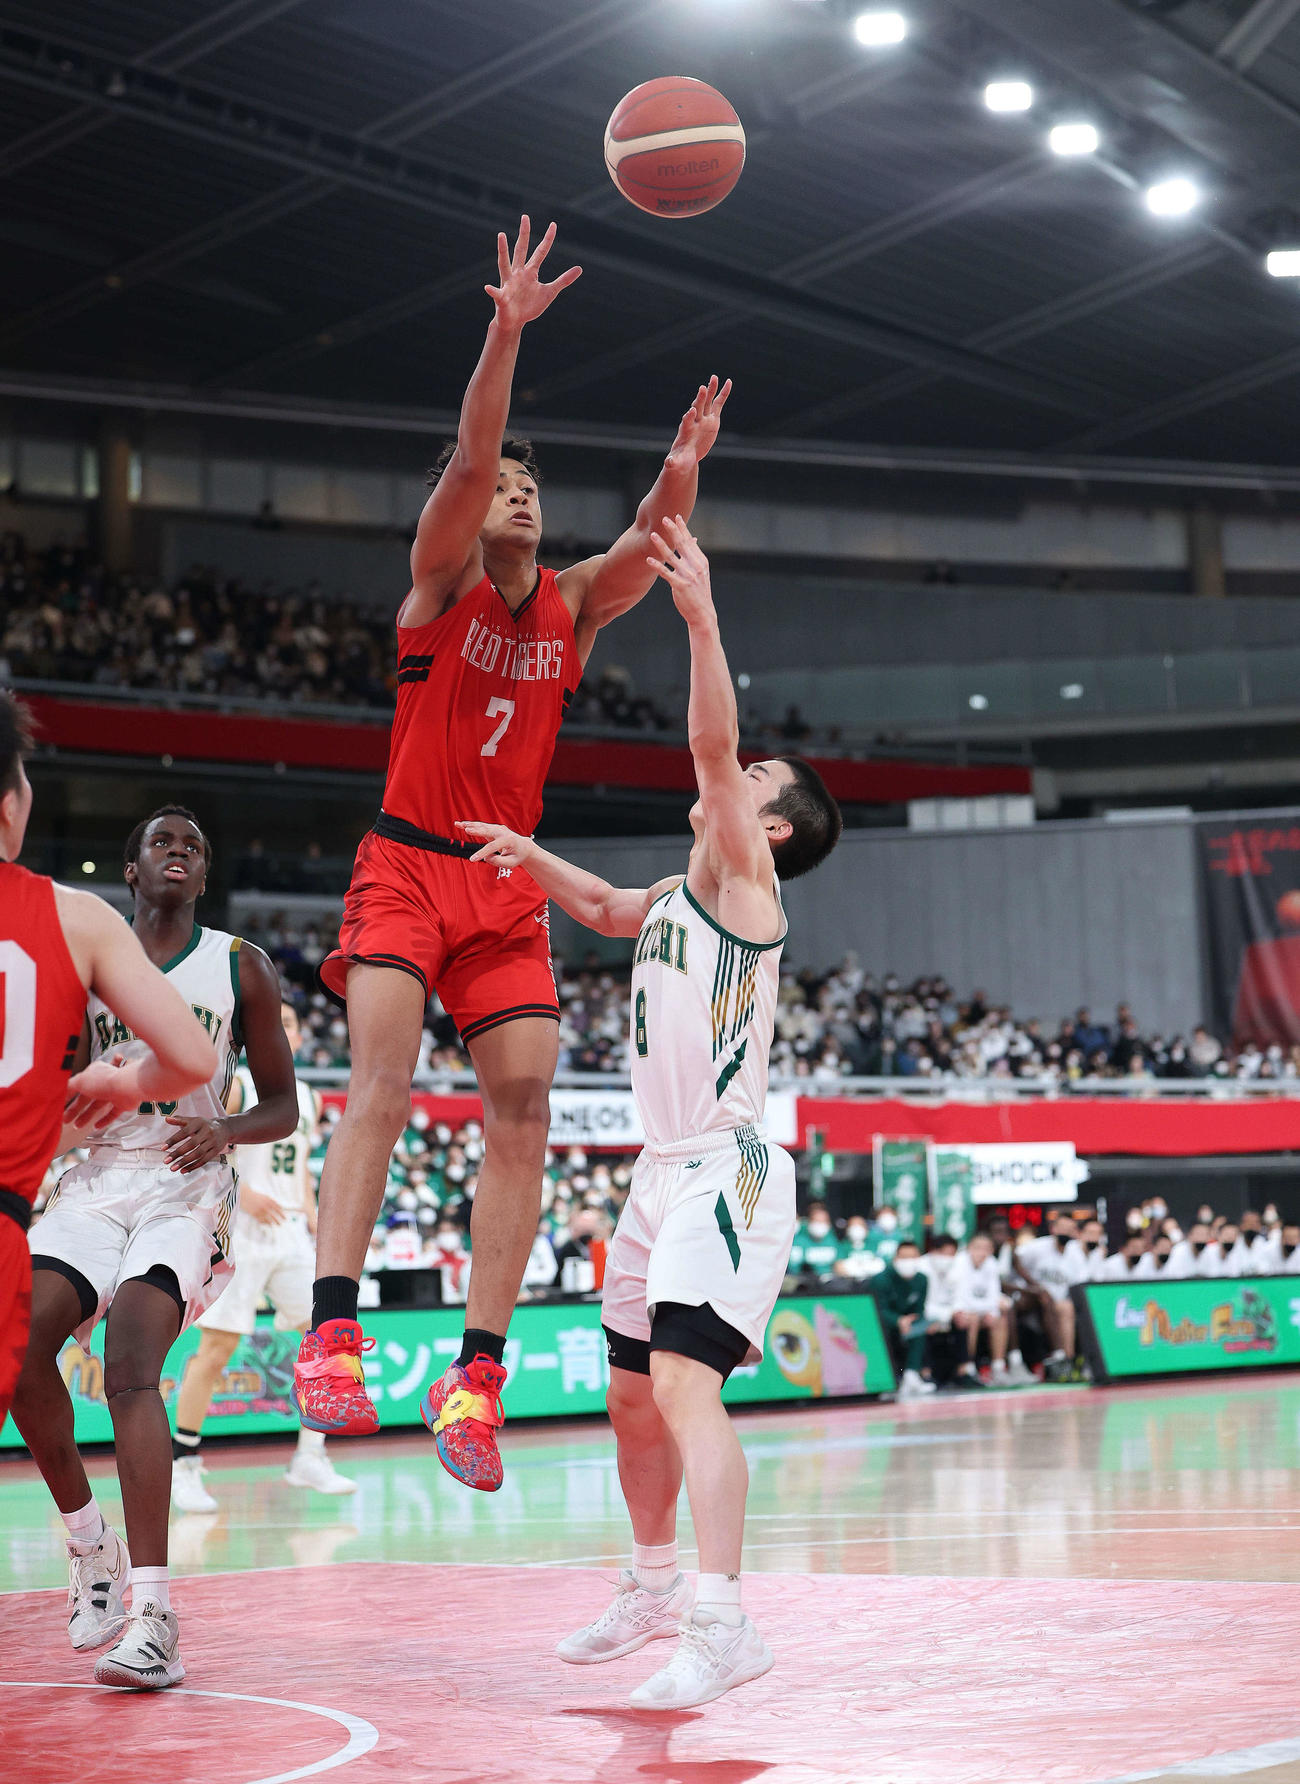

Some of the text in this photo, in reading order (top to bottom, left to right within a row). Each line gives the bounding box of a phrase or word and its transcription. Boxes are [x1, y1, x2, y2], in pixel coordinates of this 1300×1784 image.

[657, 158, 719, 177] molten
[460, 617, 503, 673] RED
[501, 639, 564, 681] TIGERS
[480, 695, 516, 757] 7
[272, 1143, 296, 1174] 52
